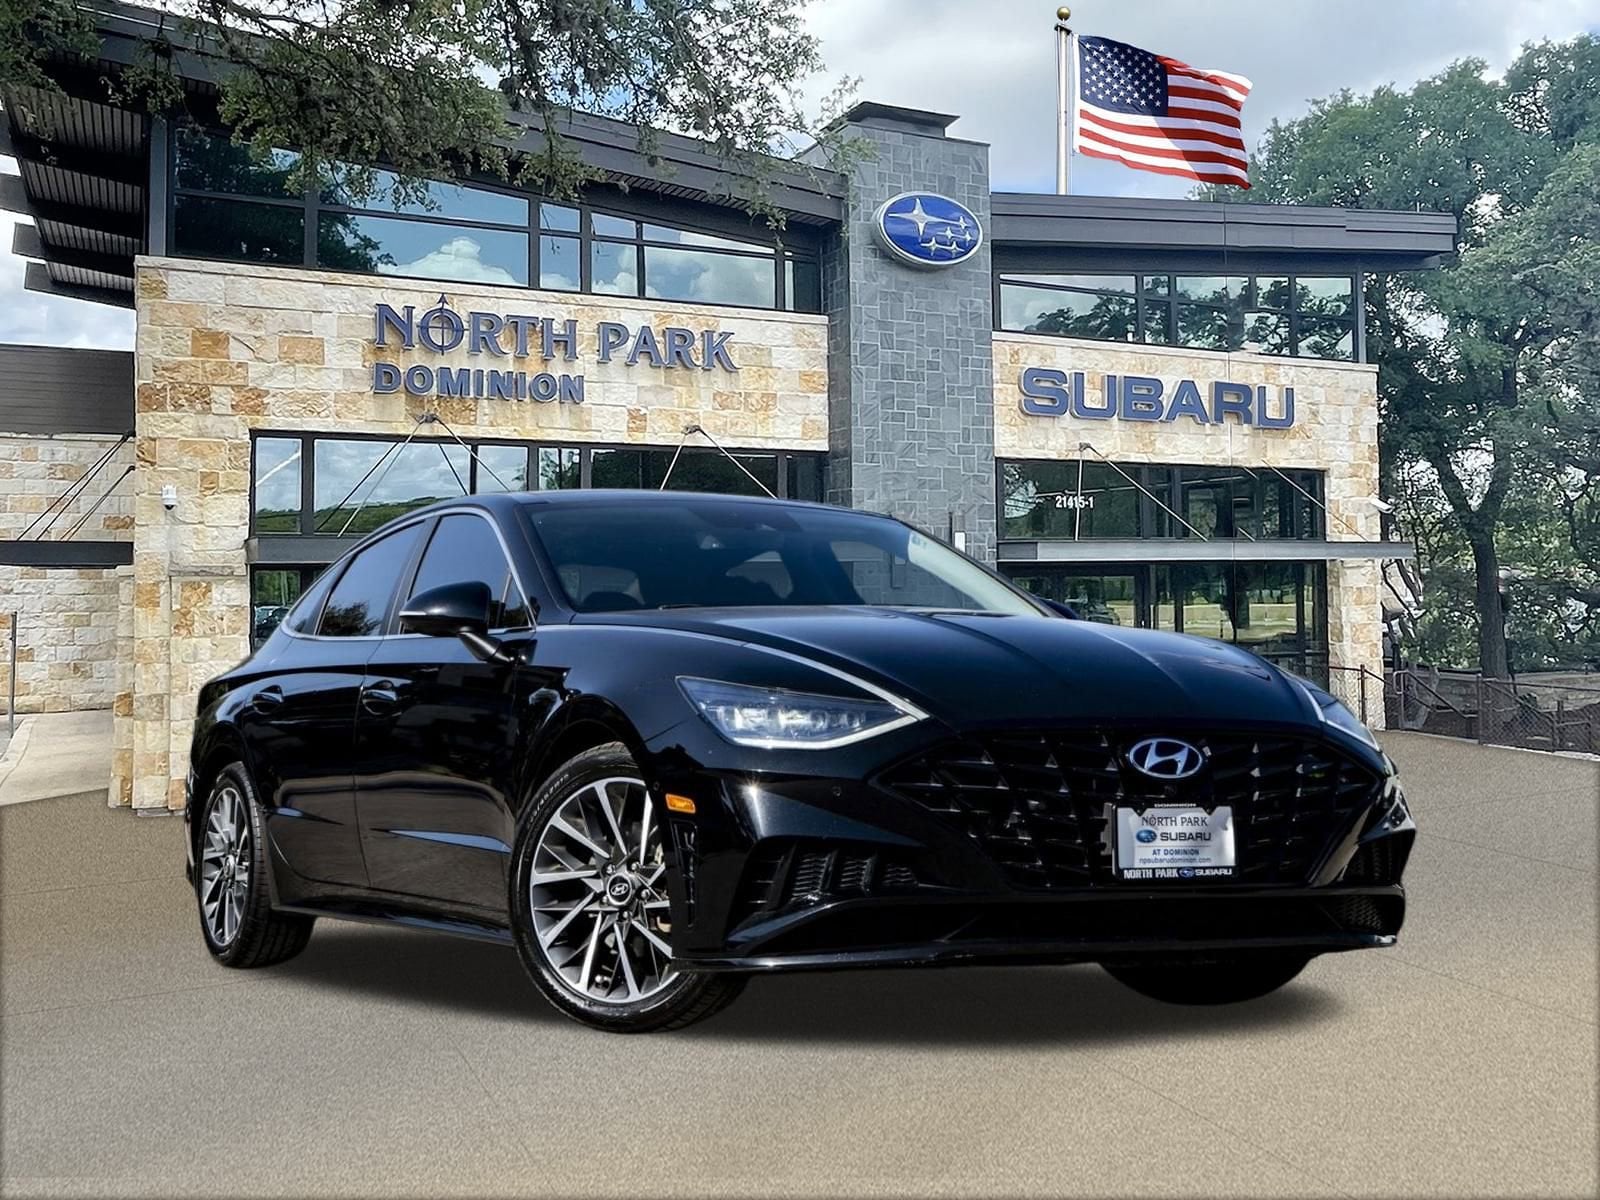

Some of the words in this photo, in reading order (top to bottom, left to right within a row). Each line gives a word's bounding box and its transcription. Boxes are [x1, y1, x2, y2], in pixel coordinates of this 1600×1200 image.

[375, 302, 578, 361] NORTH
[597, 321, 742, 373] PARK
[373, 362, 585, 404] DOMINION
[1019, 367, 1294, 430] SUBARU
[1141, 815, 1178, 827] NORTH
[1180, 816, 1208, 827] PARK
[1159, 832, 1212, 842] SUBARU
[1123, 868, 1153, 879] NORTH
[1155, 868, 1179, 878] PARK
[1195, 868, 1232, 877] SUBARU
